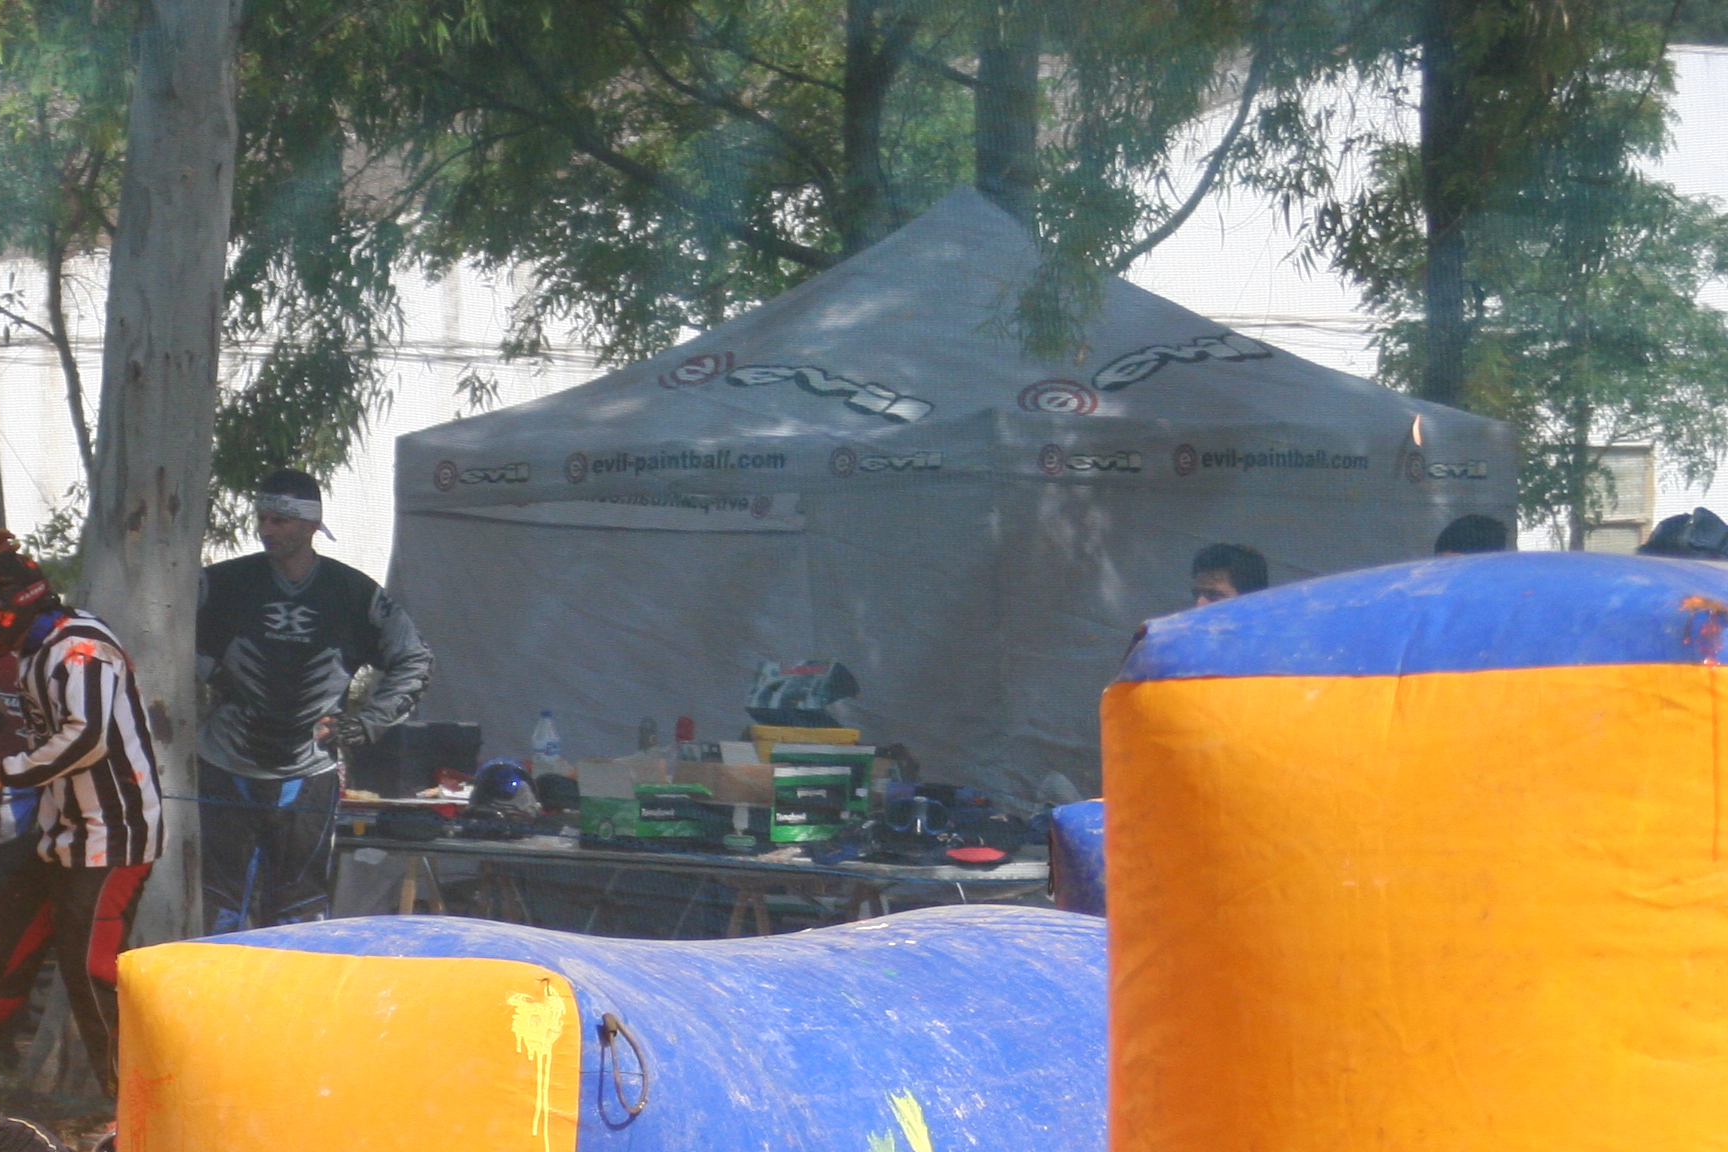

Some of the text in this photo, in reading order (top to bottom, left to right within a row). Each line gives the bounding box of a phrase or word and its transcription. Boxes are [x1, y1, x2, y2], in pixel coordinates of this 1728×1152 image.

[1091, 333, 1273, 391] evil
[725, 364, 936, 424] evil
[458, 462, 531, 484] evil
[591, 449, 786, 477] evil-paintball.com
[1065, 450, 1142, 472] evil
[1201, 448, 1369, 472] evil-paintball.com
